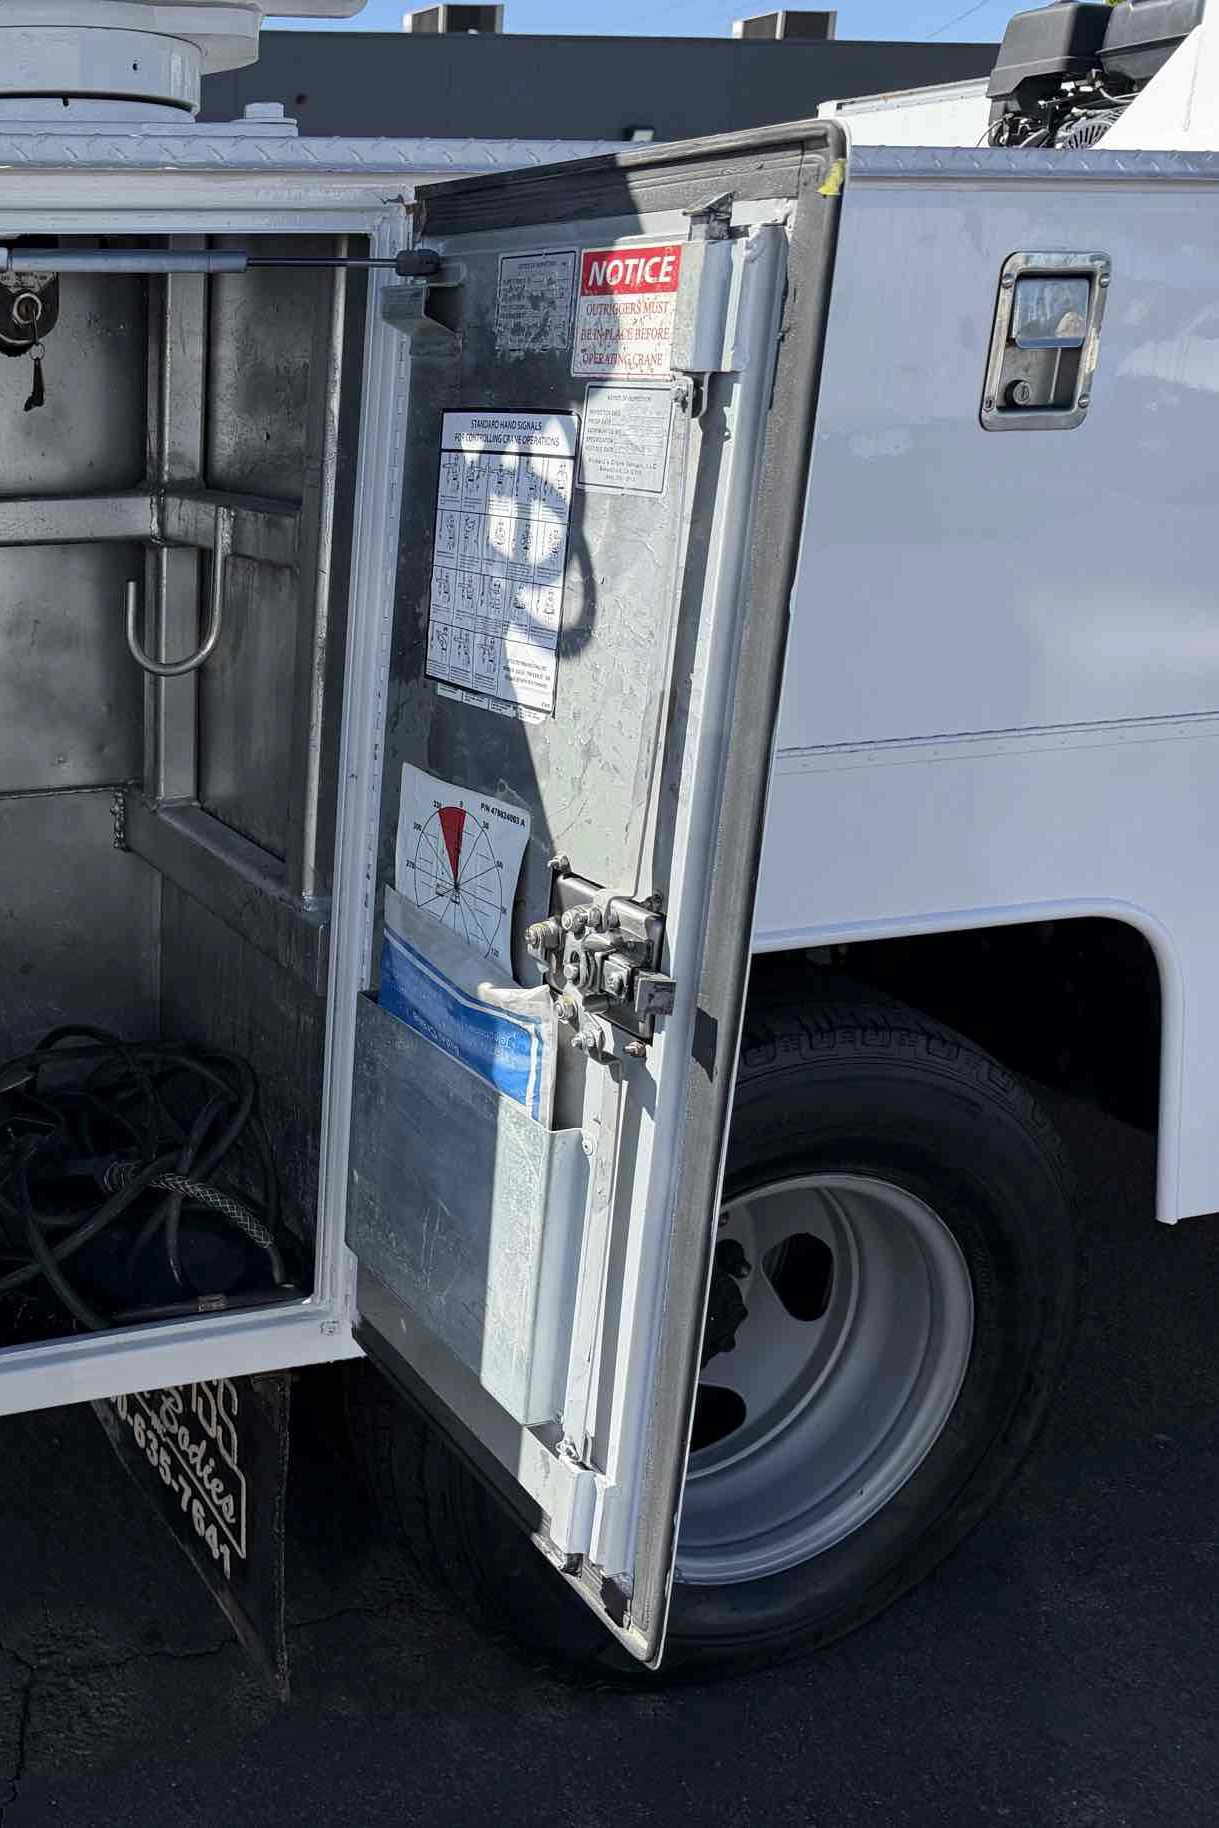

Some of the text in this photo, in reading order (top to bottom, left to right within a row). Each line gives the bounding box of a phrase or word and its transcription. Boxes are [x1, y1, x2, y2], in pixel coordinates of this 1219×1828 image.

[588, 255, 676, 287] NOTICE
[586, 302, 669, 315] OUTRIGGERS MUST
[635, 328, 670, 340] BEFORE
[582, 352, 663, 365] OPERATING CRANE
[471, 419, 542, 431] STANDARD HAND SIGNALS
[522, 434, 560, 447] OPERATIONS
